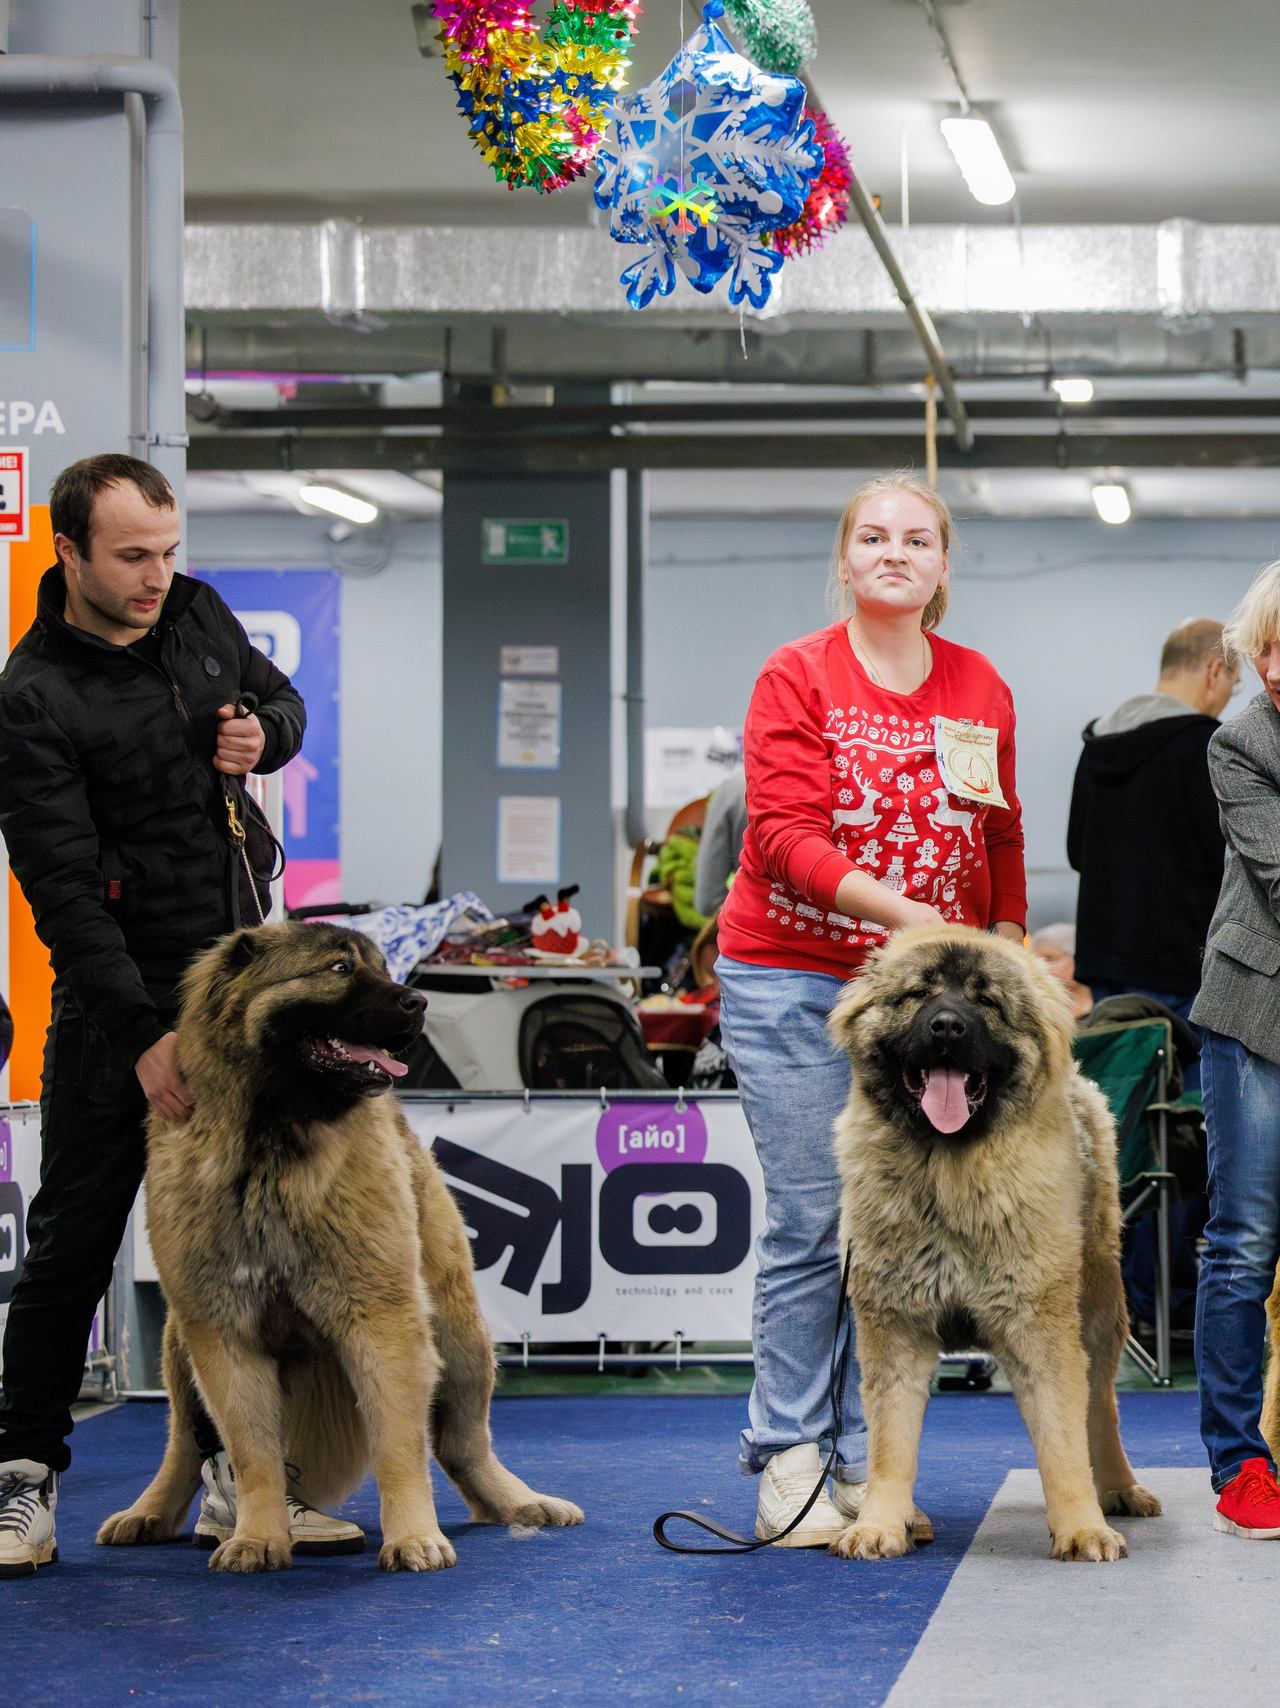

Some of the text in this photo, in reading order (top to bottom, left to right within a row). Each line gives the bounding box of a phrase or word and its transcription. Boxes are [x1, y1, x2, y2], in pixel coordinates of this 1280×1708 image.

[0, 400, 66, 435] РА
[615, 1285, 734, 1297] technology and care
